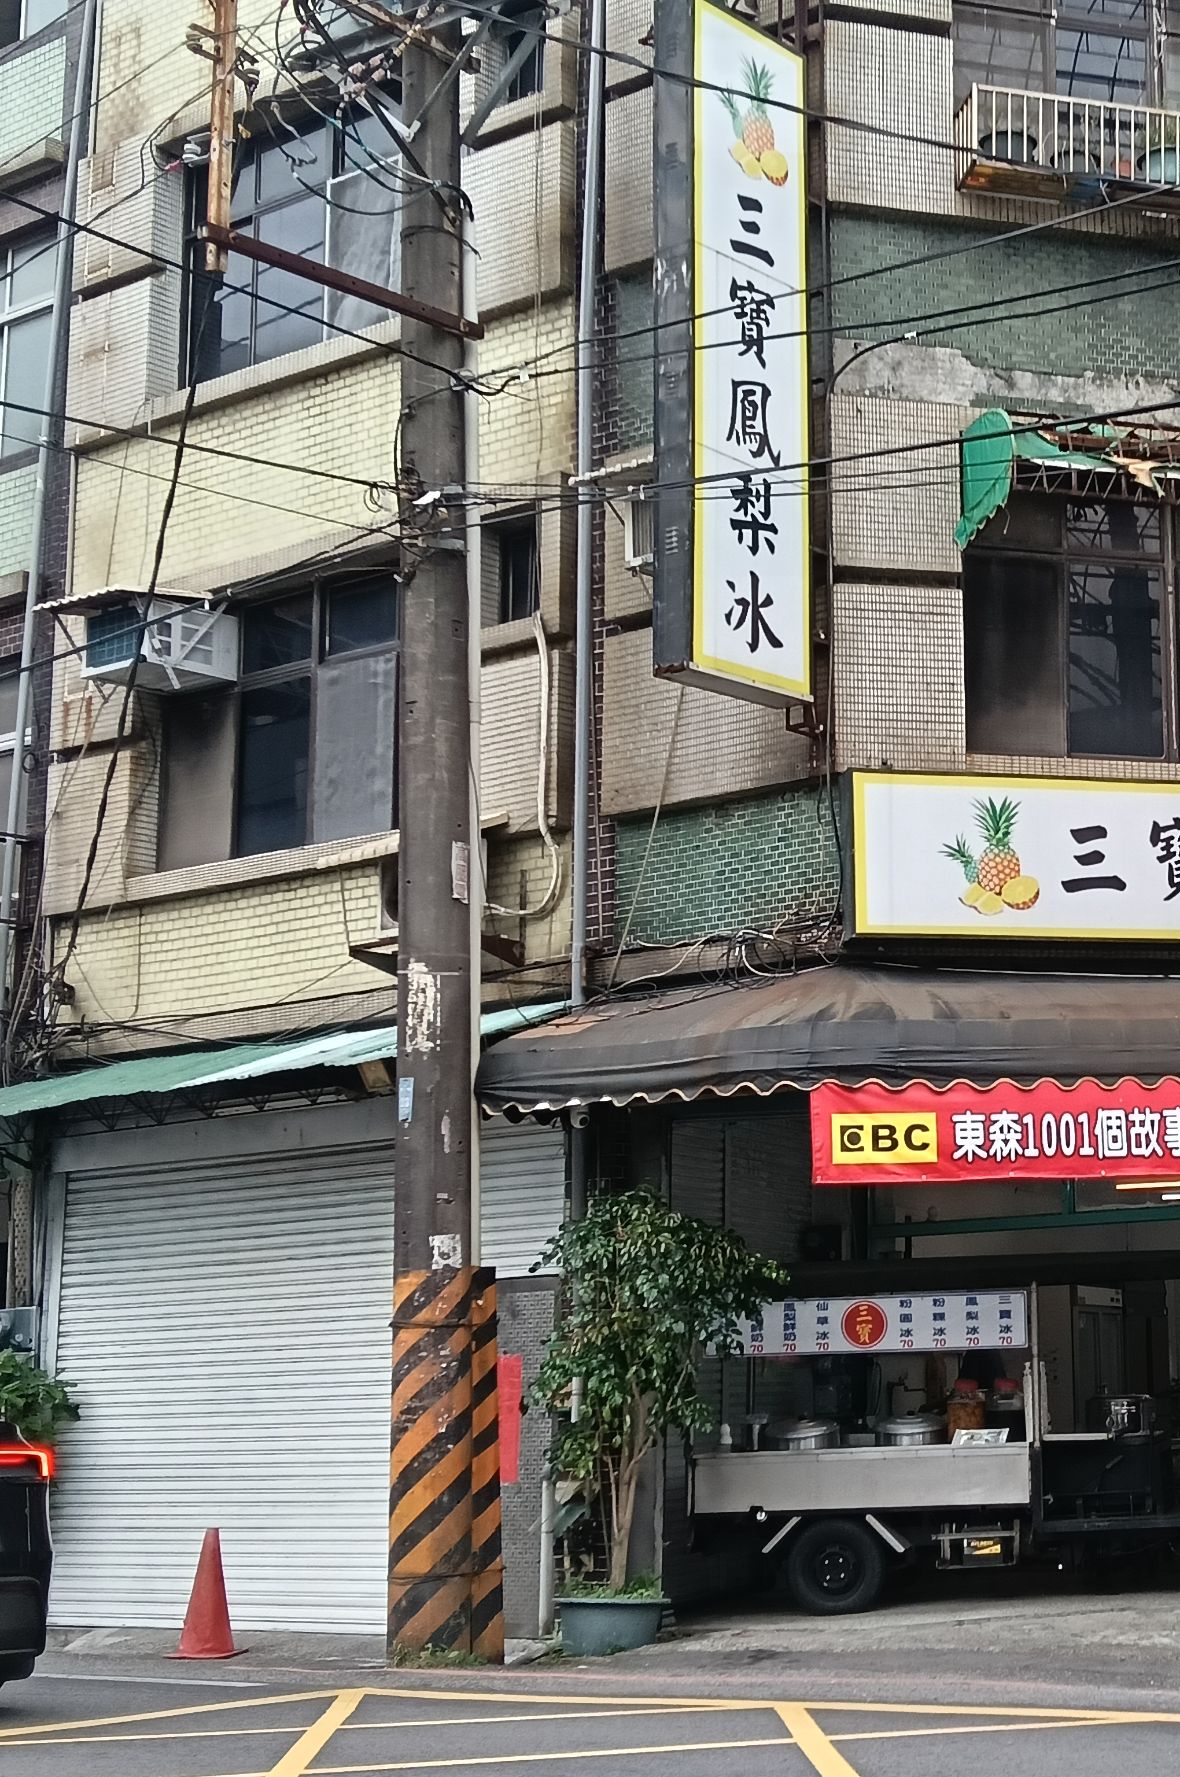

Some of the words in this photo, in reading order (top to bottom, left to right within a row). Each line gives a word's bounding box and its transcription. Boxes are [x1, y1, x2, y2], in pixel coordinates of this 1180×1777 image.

[725, 193, 784, 654] 三寶鳳梨冰
[900, 1339, 914, 1348] 70
[933, 1338, 947, 1347] 70
[966, 1337, 980, 1346] 70
[999, 1336, 1013, 1345] 70
[750, 1344, 764, 1354] 70
[783, 1343, 797, 1352] 70
[816, 1342, 829, 1351] 70
